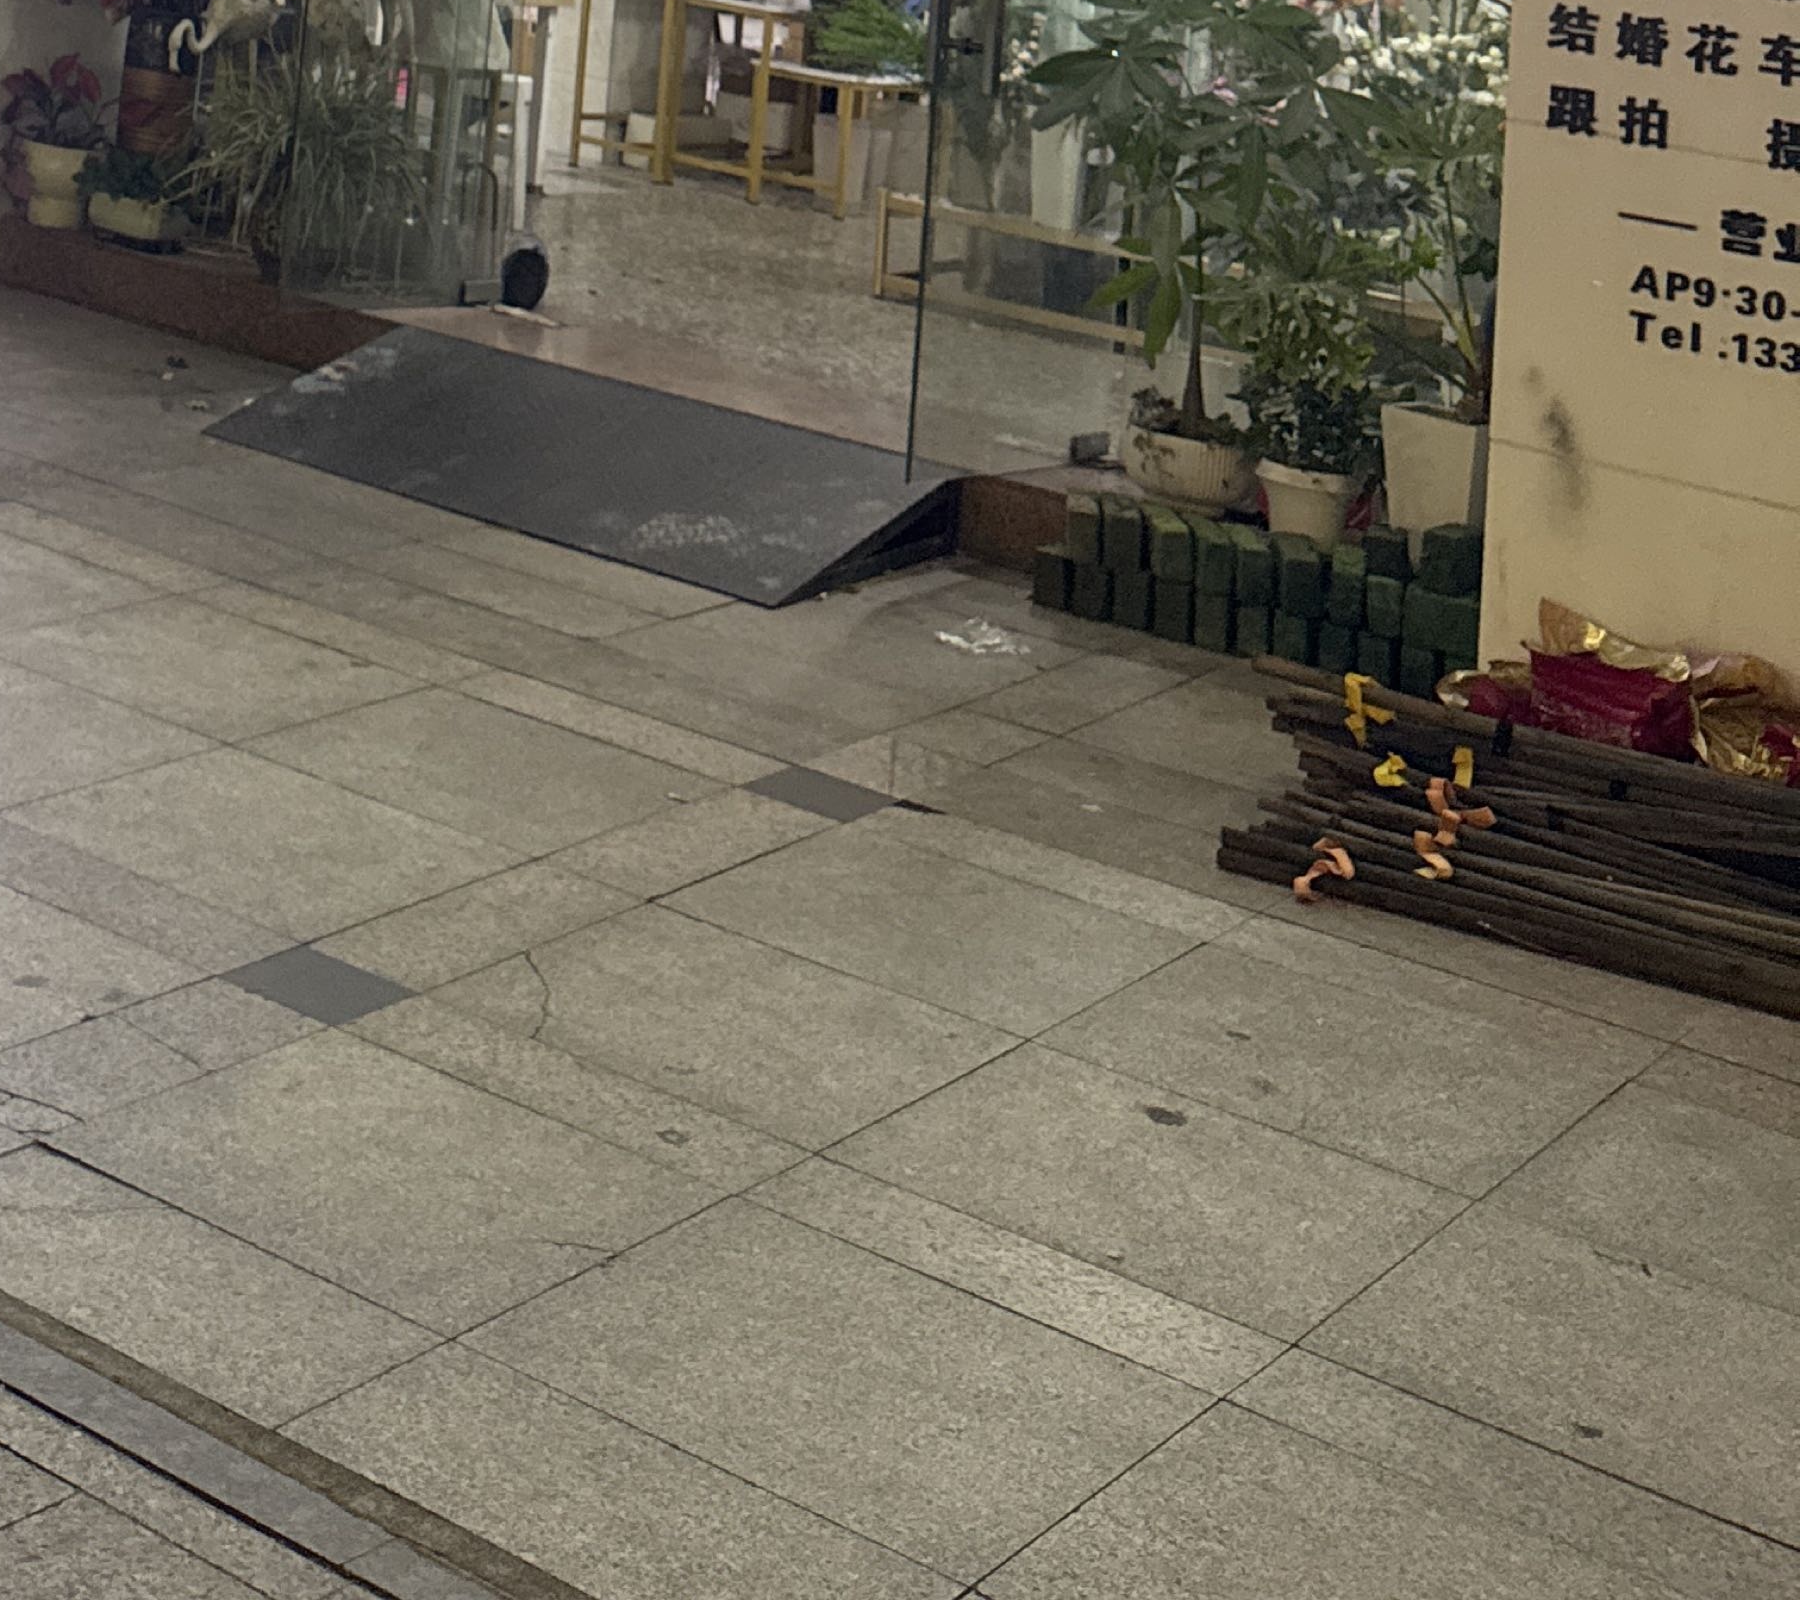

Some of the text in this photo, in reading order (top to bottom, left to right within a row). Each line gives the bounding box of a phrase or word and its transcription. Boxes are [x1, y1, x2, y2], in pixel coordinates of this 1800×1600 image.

[1546, 2, 1800, 87] 结婚花车
[1545, 84, 1670, 149] 跟拍
